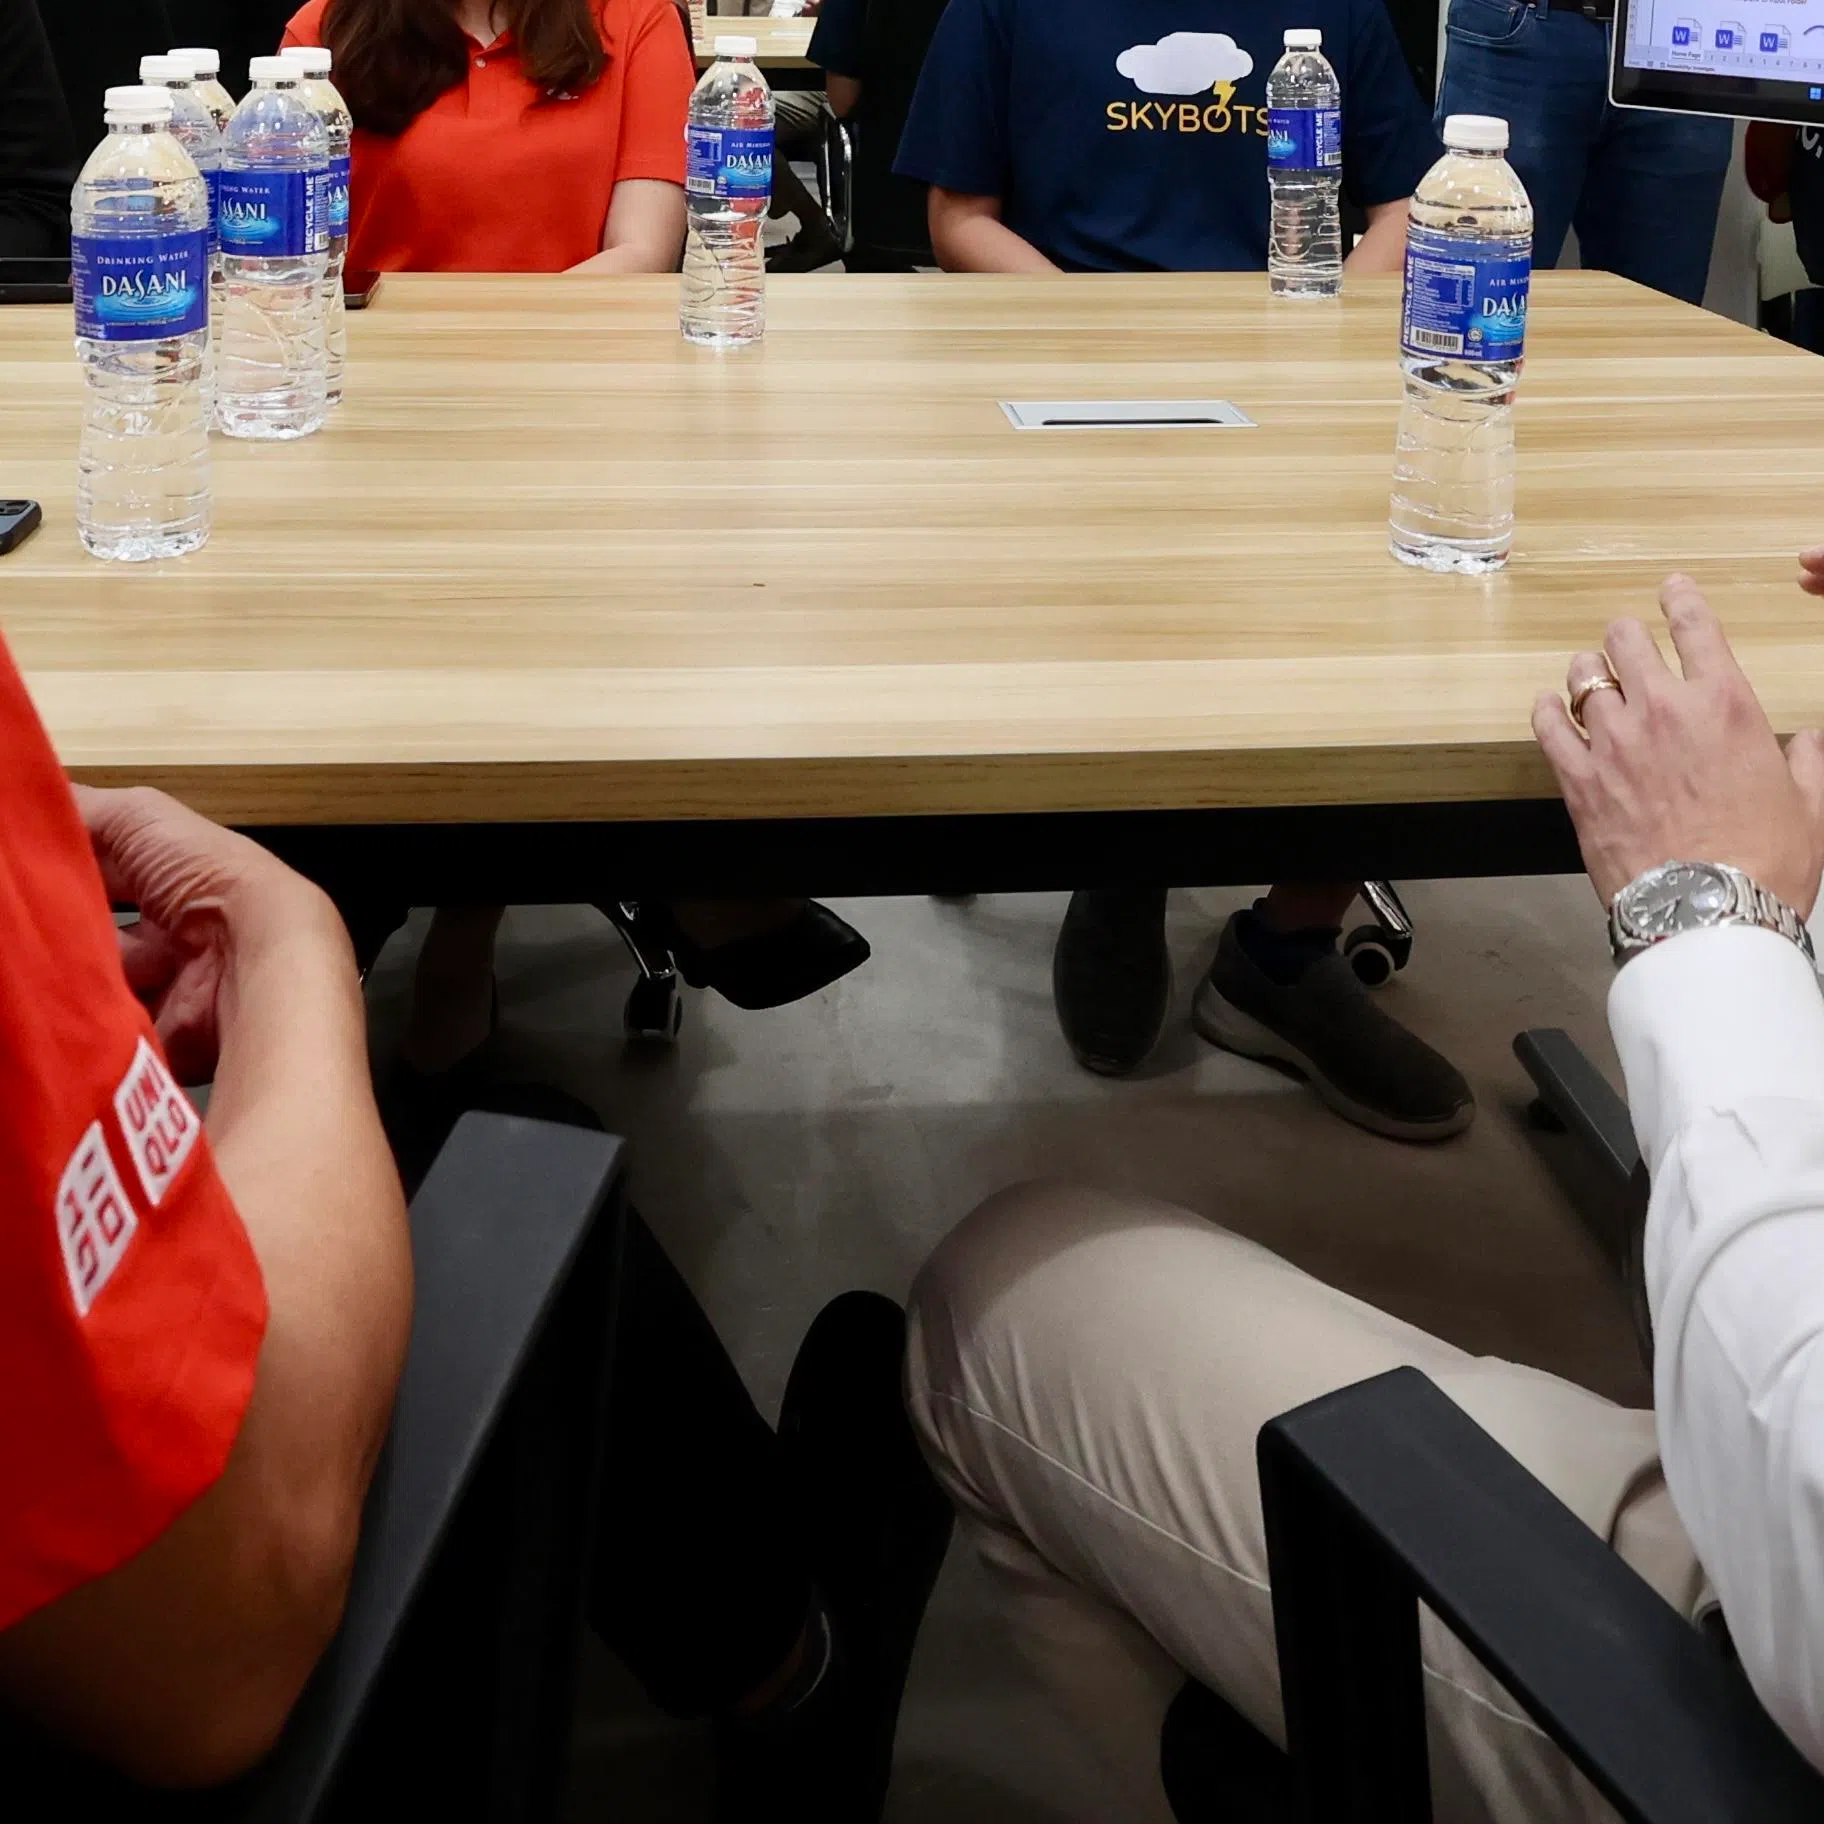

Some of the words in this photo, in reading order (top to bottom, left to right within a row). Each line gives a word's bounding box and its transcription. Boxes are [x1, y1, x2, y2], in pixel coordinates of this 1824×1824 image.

[1105, 101, 1269, 137] SKYBOTS
[1316, 112, 1323, 127] ME
[241, 186, 270, 194] WATER
[305, 176, 314, 196] ME
[305, 196, 314, 253] RECYCLE
[96, 256, 154, 265] DRINKING
[158, 251, 188, 263] WATER
[1406, 256, 1414, 278] ME
[102, 269, 186, 301] DASANI
[1489, 278, 1506, 287] AIR
[1403, 281, 1413, 344] RECYCLE
[144, 1097, 186, 1176] QLO
